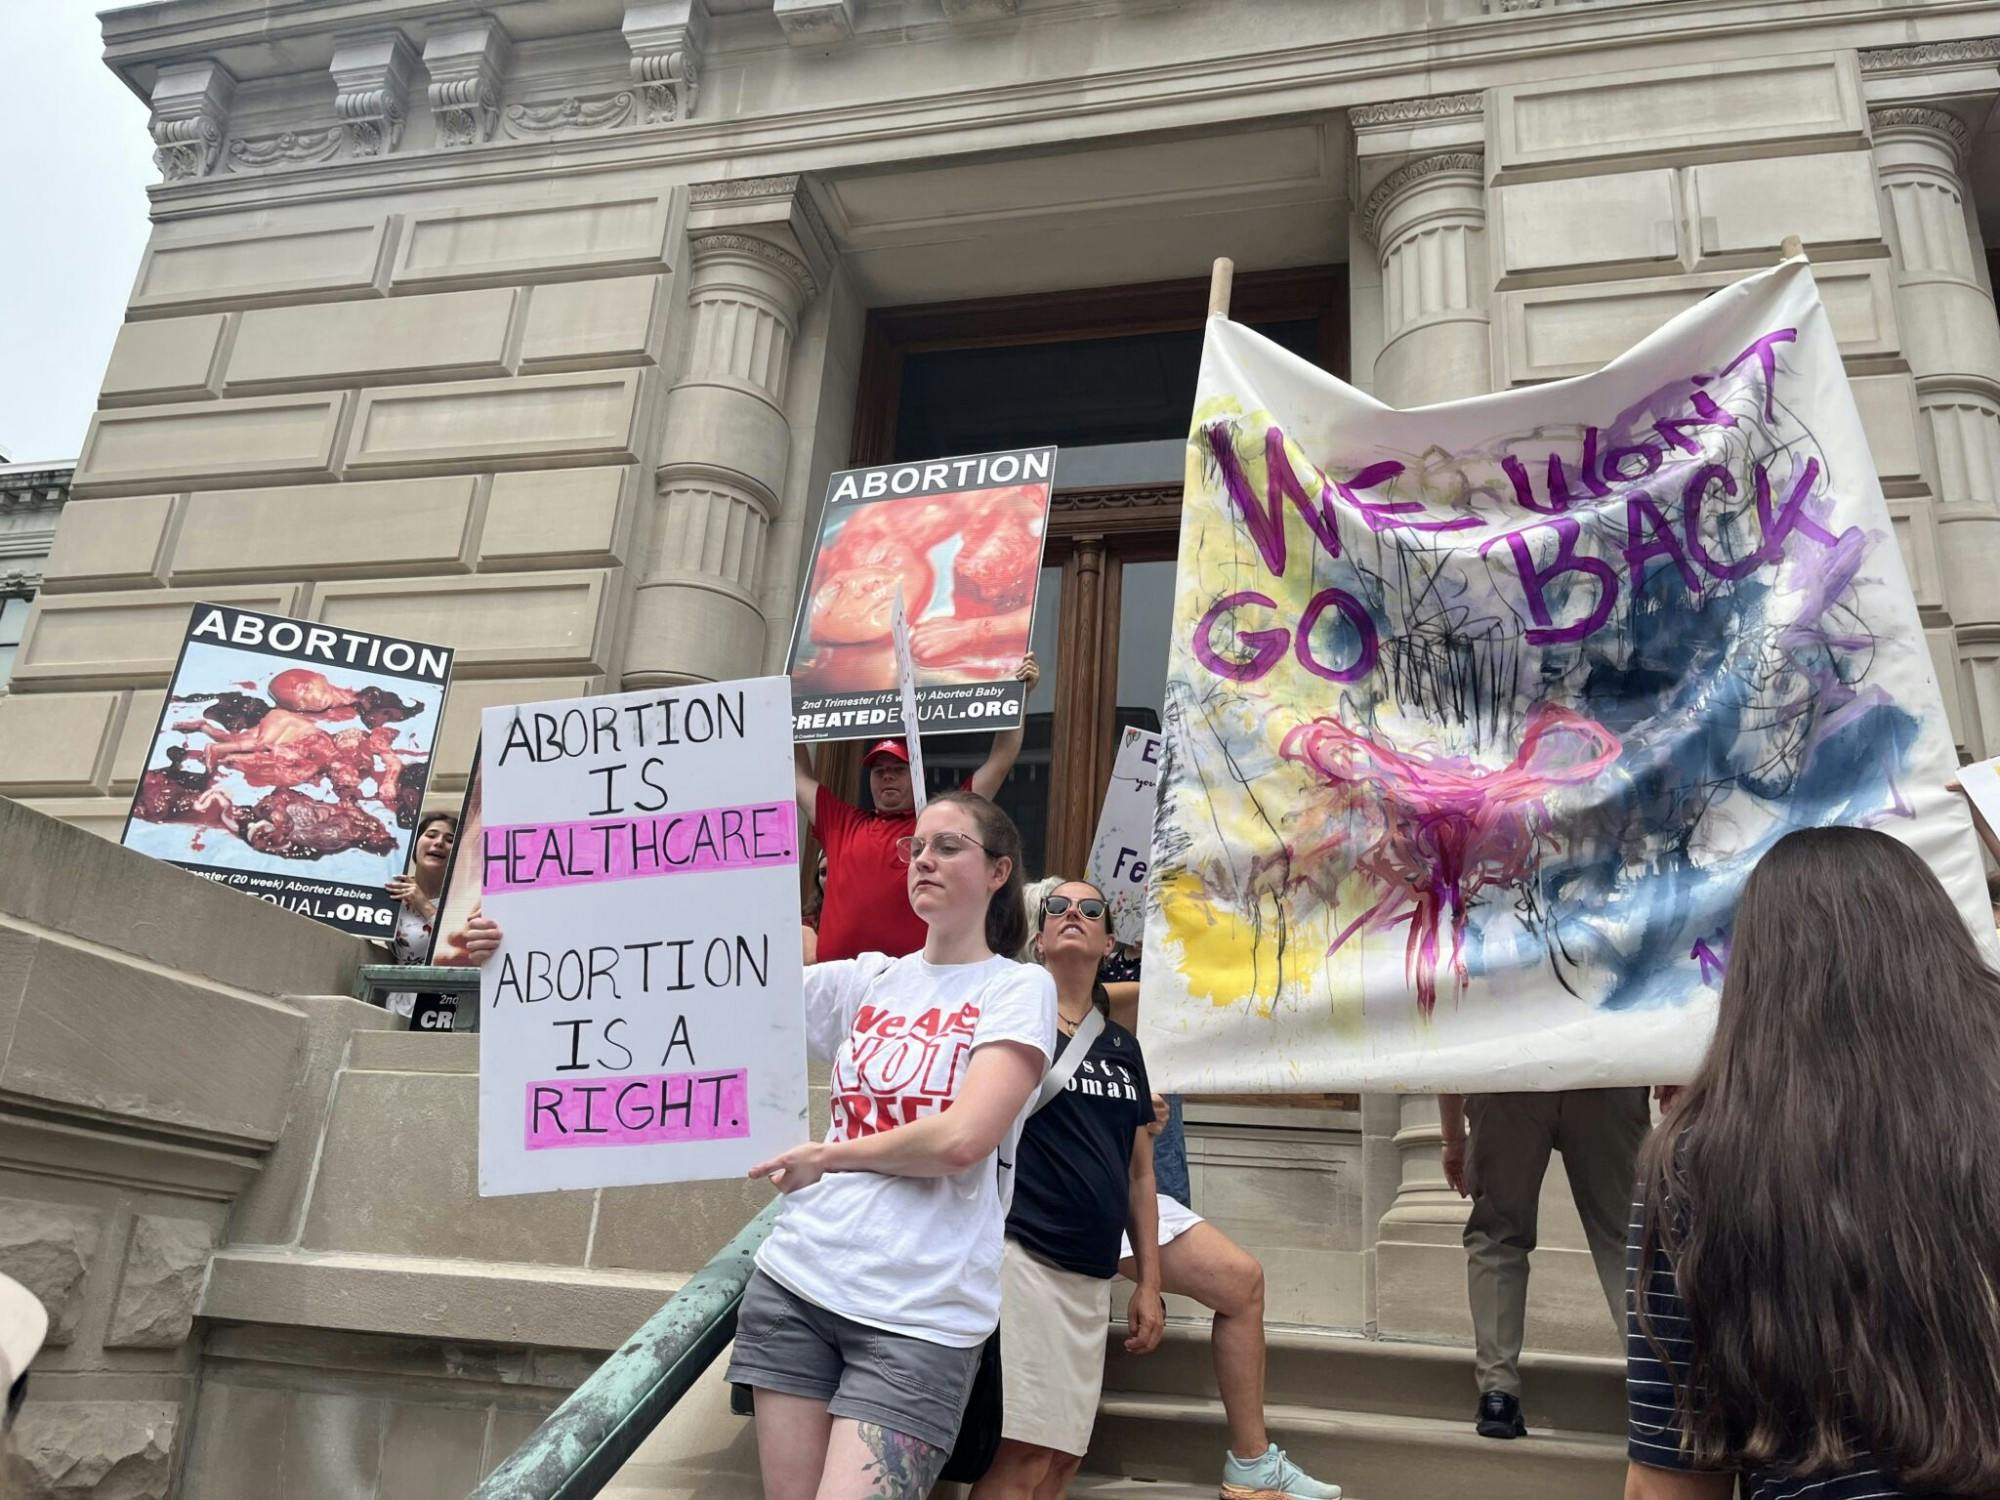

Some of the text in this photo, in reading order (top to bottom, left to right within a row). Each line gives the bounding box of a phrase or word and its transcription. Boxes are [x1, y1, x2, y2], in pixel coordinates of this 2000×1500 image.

[831, 451, 1050, 503] ABORTION
[1209, 420, 1487, 578] WE
[1192, 456, 1840, 683] GO BACK
[192, 609, 449, 680] ABORTION
[791, 699, 1020, 731] REATEDEUAL.ORG
[801, 686, 1005, 710] 2nd Trimester (15 wk) Aborted Baby
[498, 690, 746, 767] ABORTION
[1141, 738, 1160, 764] E
[588, 757, 669, 816] IS
[482, 806, 792, 887] HEALTHCARE.
[1112, 847, 1147, 884] Fe
[228, 873, 248, 885] (20
[250, 875, 284, 891] week)
[284, 880, 333, 896] Aborted
[334, 887, 373, 901] Babies
[493, 933, 770, 1009] ABORTION
[420, 1010, 457, 1029] CR
[553, 1014, 696, 1072] IS A
[831, 1031, 974, 1097] NOT
[1065, 1076, 1137, 1101] oman
[1082, 1060, 1131, 1084] sty
[532, 1073, 739, 1135] RIGHT.
